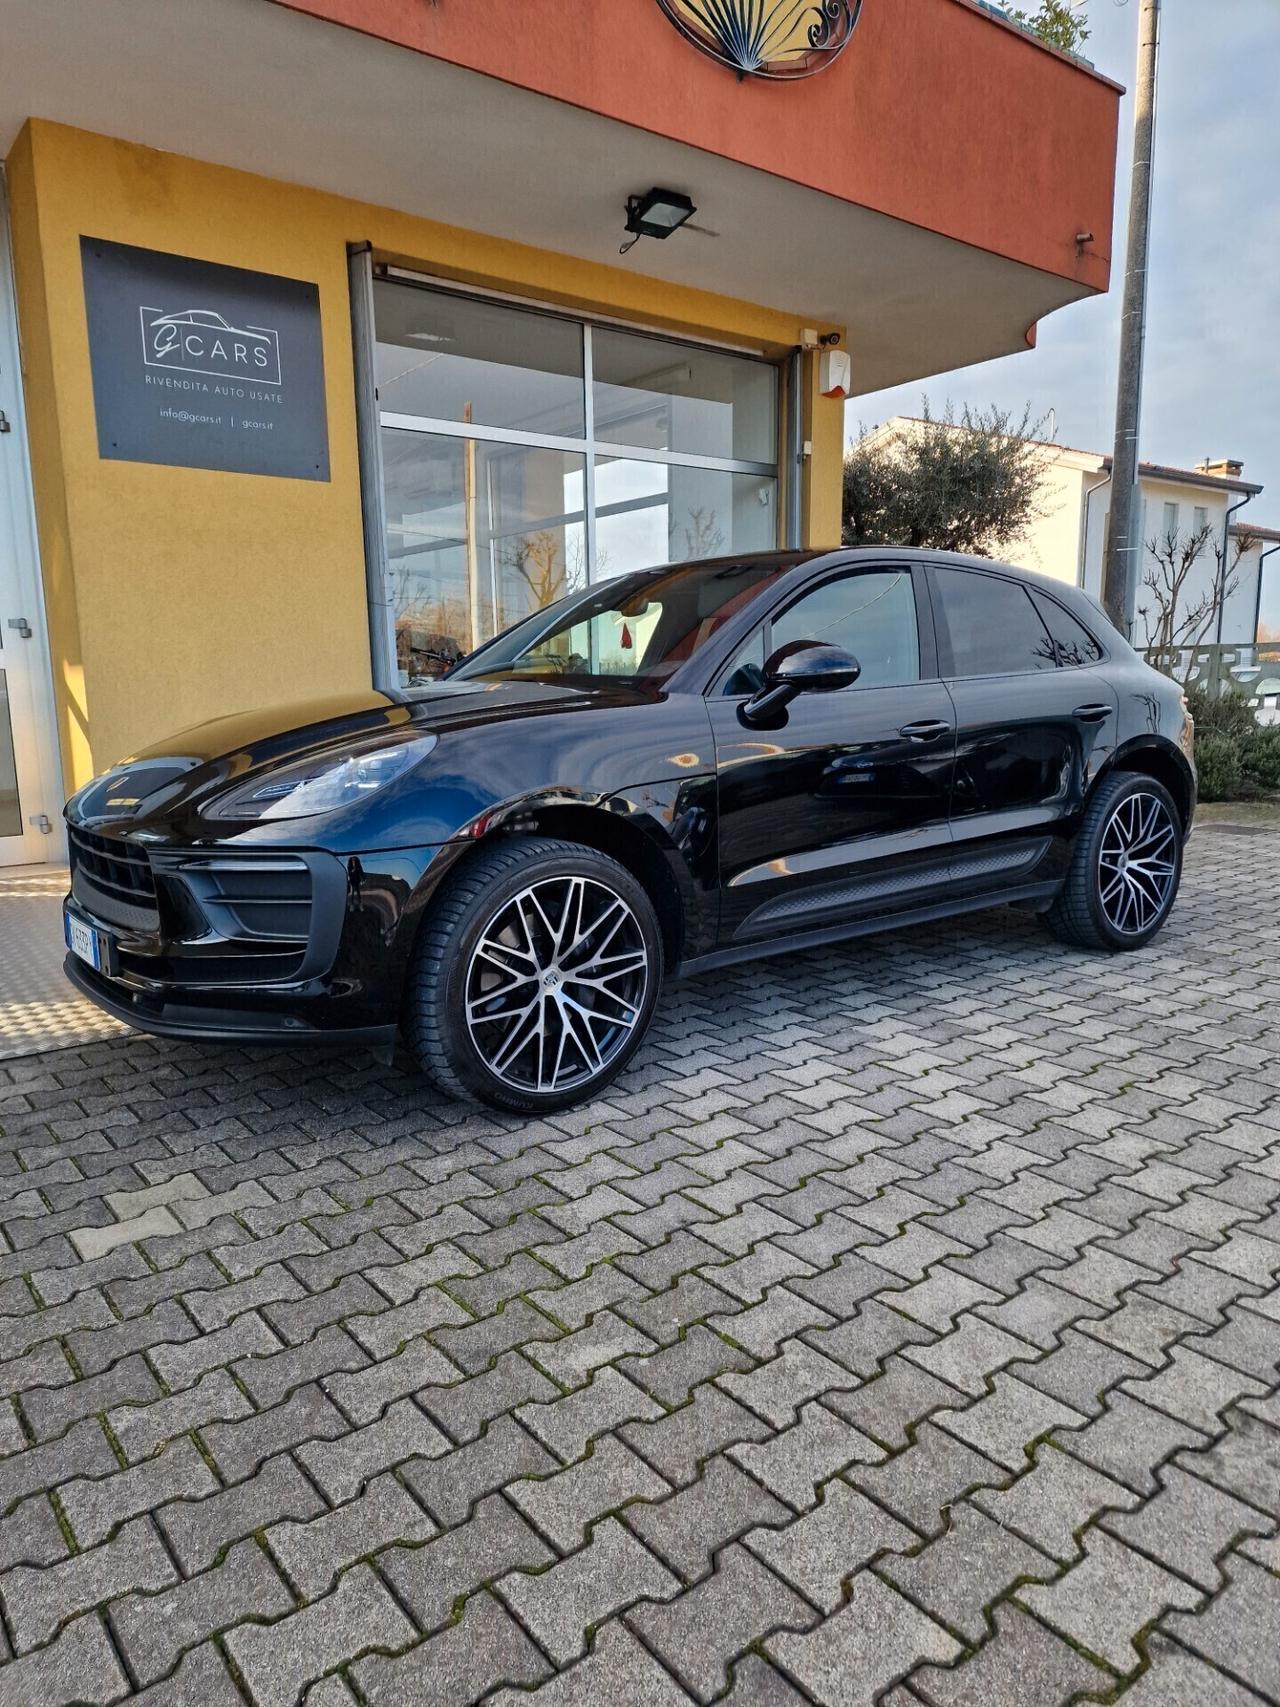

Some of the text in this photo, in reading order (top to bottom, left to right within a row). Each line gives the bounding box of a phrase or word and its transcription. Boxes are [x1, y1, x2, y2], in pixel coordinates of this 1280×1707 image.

[145, 375, 284, 404] RIVENDITA AUTO USATE
[160, 407, 274, 430] info@gcars.it gcars.it
